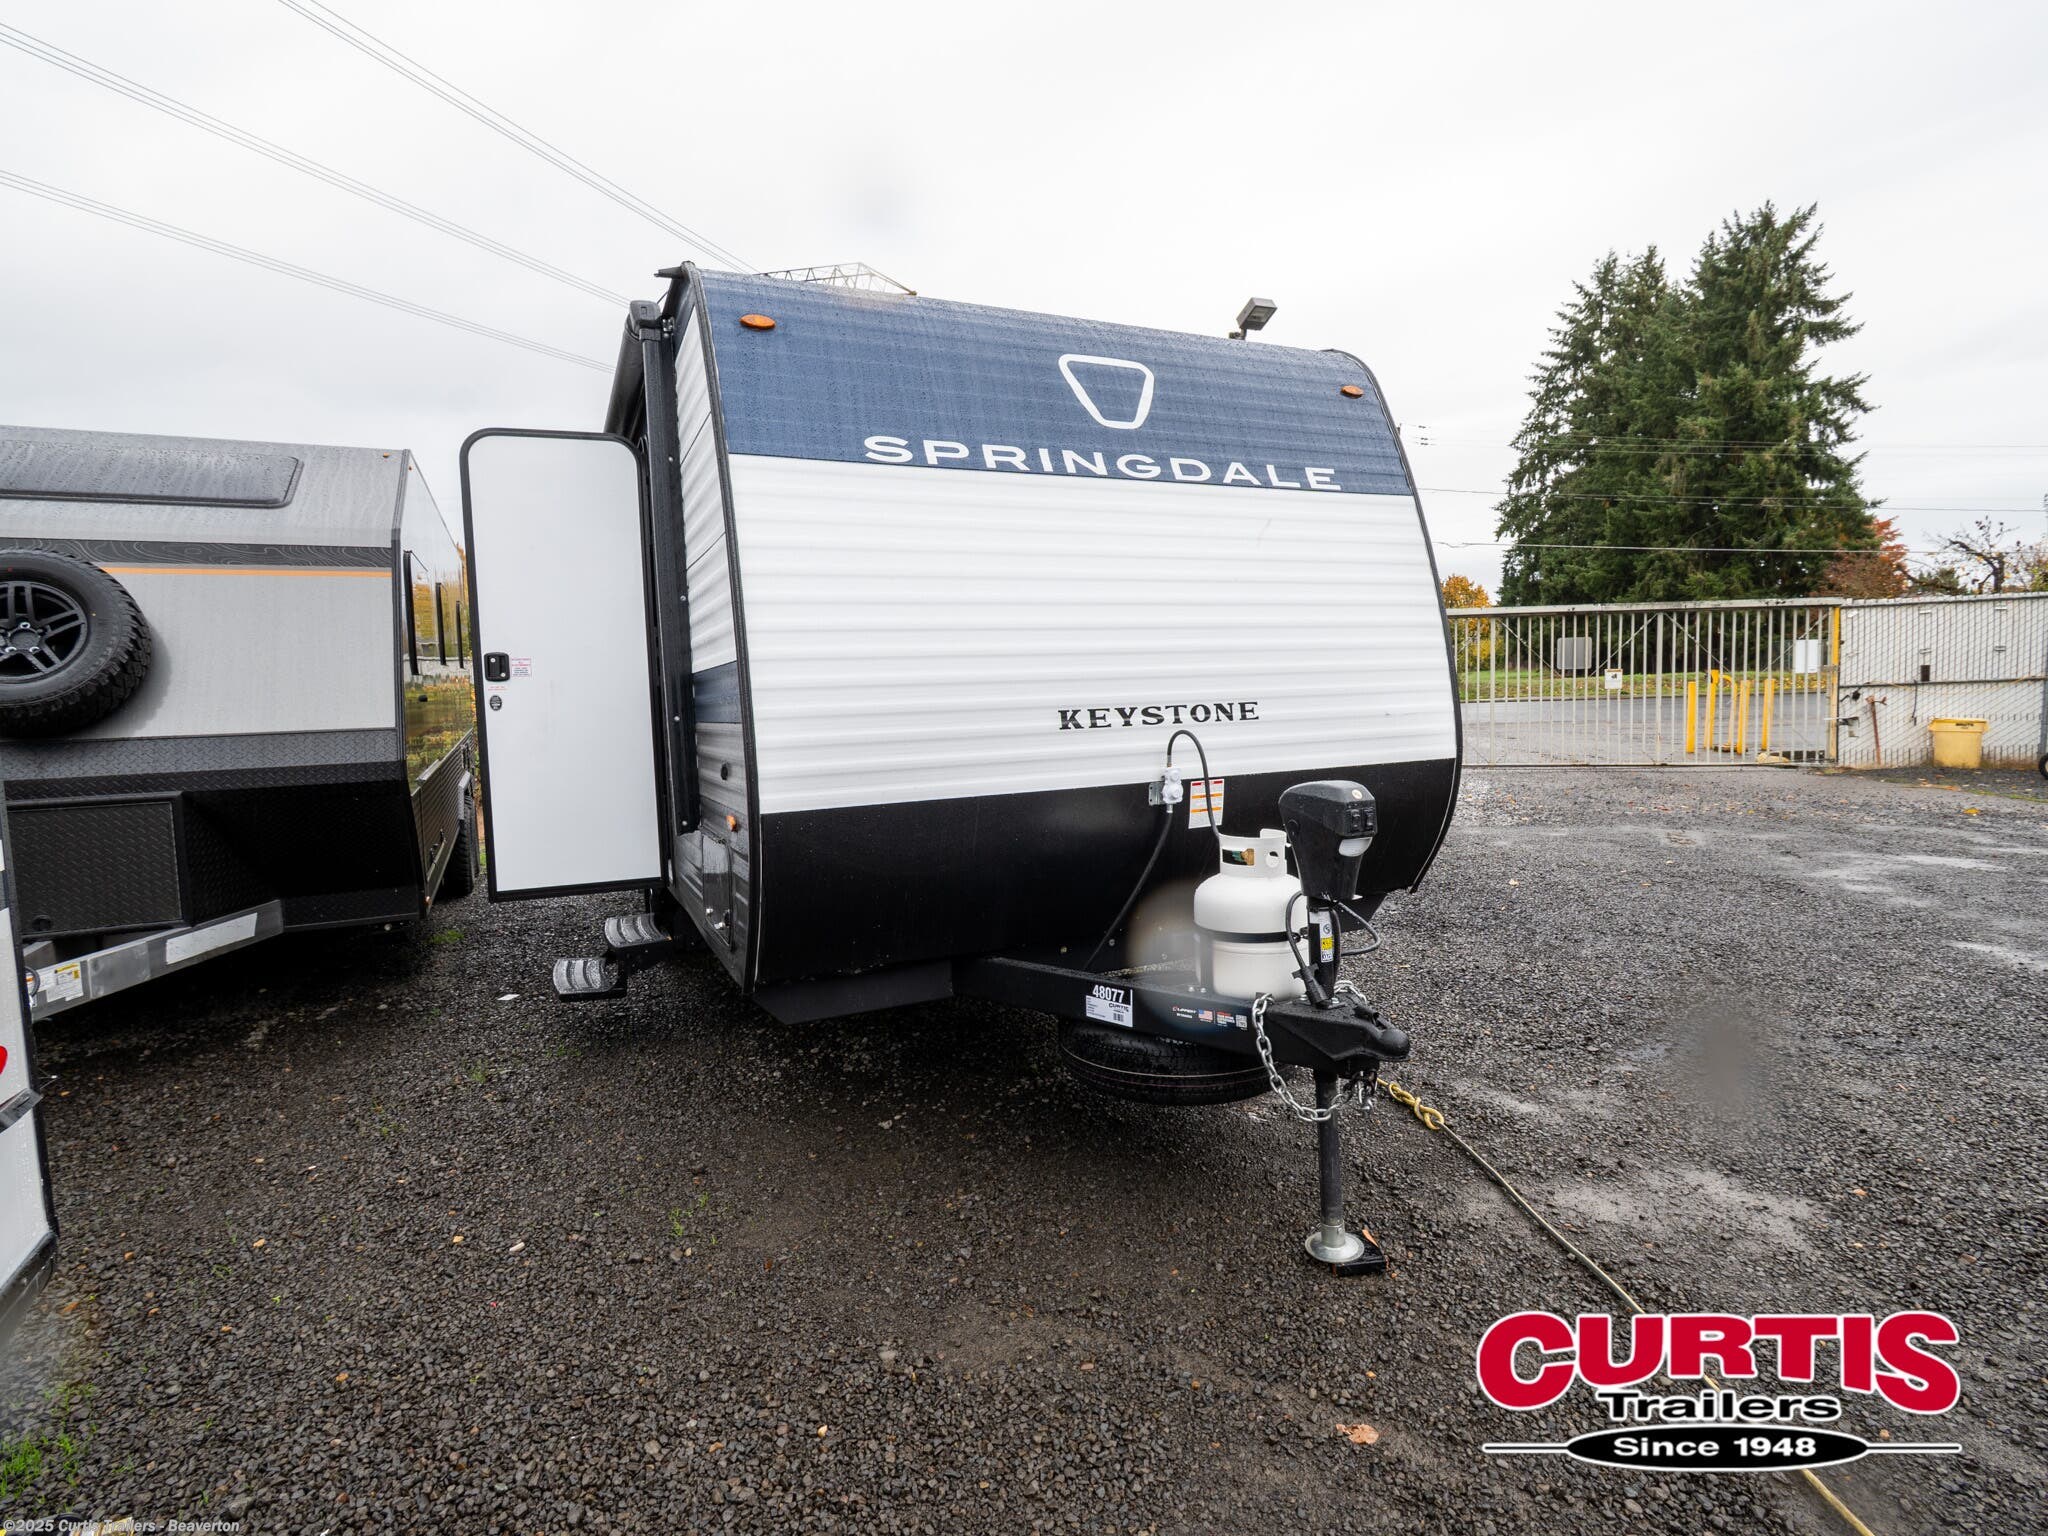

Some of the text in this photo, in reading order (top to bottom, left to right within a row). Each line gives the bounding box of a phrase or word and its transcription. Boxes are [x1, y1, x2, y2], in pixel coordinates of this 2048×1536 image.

[864, 435, 1342, 491] SPRINGDALE
[1058, 701, 1260, 730] KEYSTONE
[1092, 984, 1125, 1003] 48077
